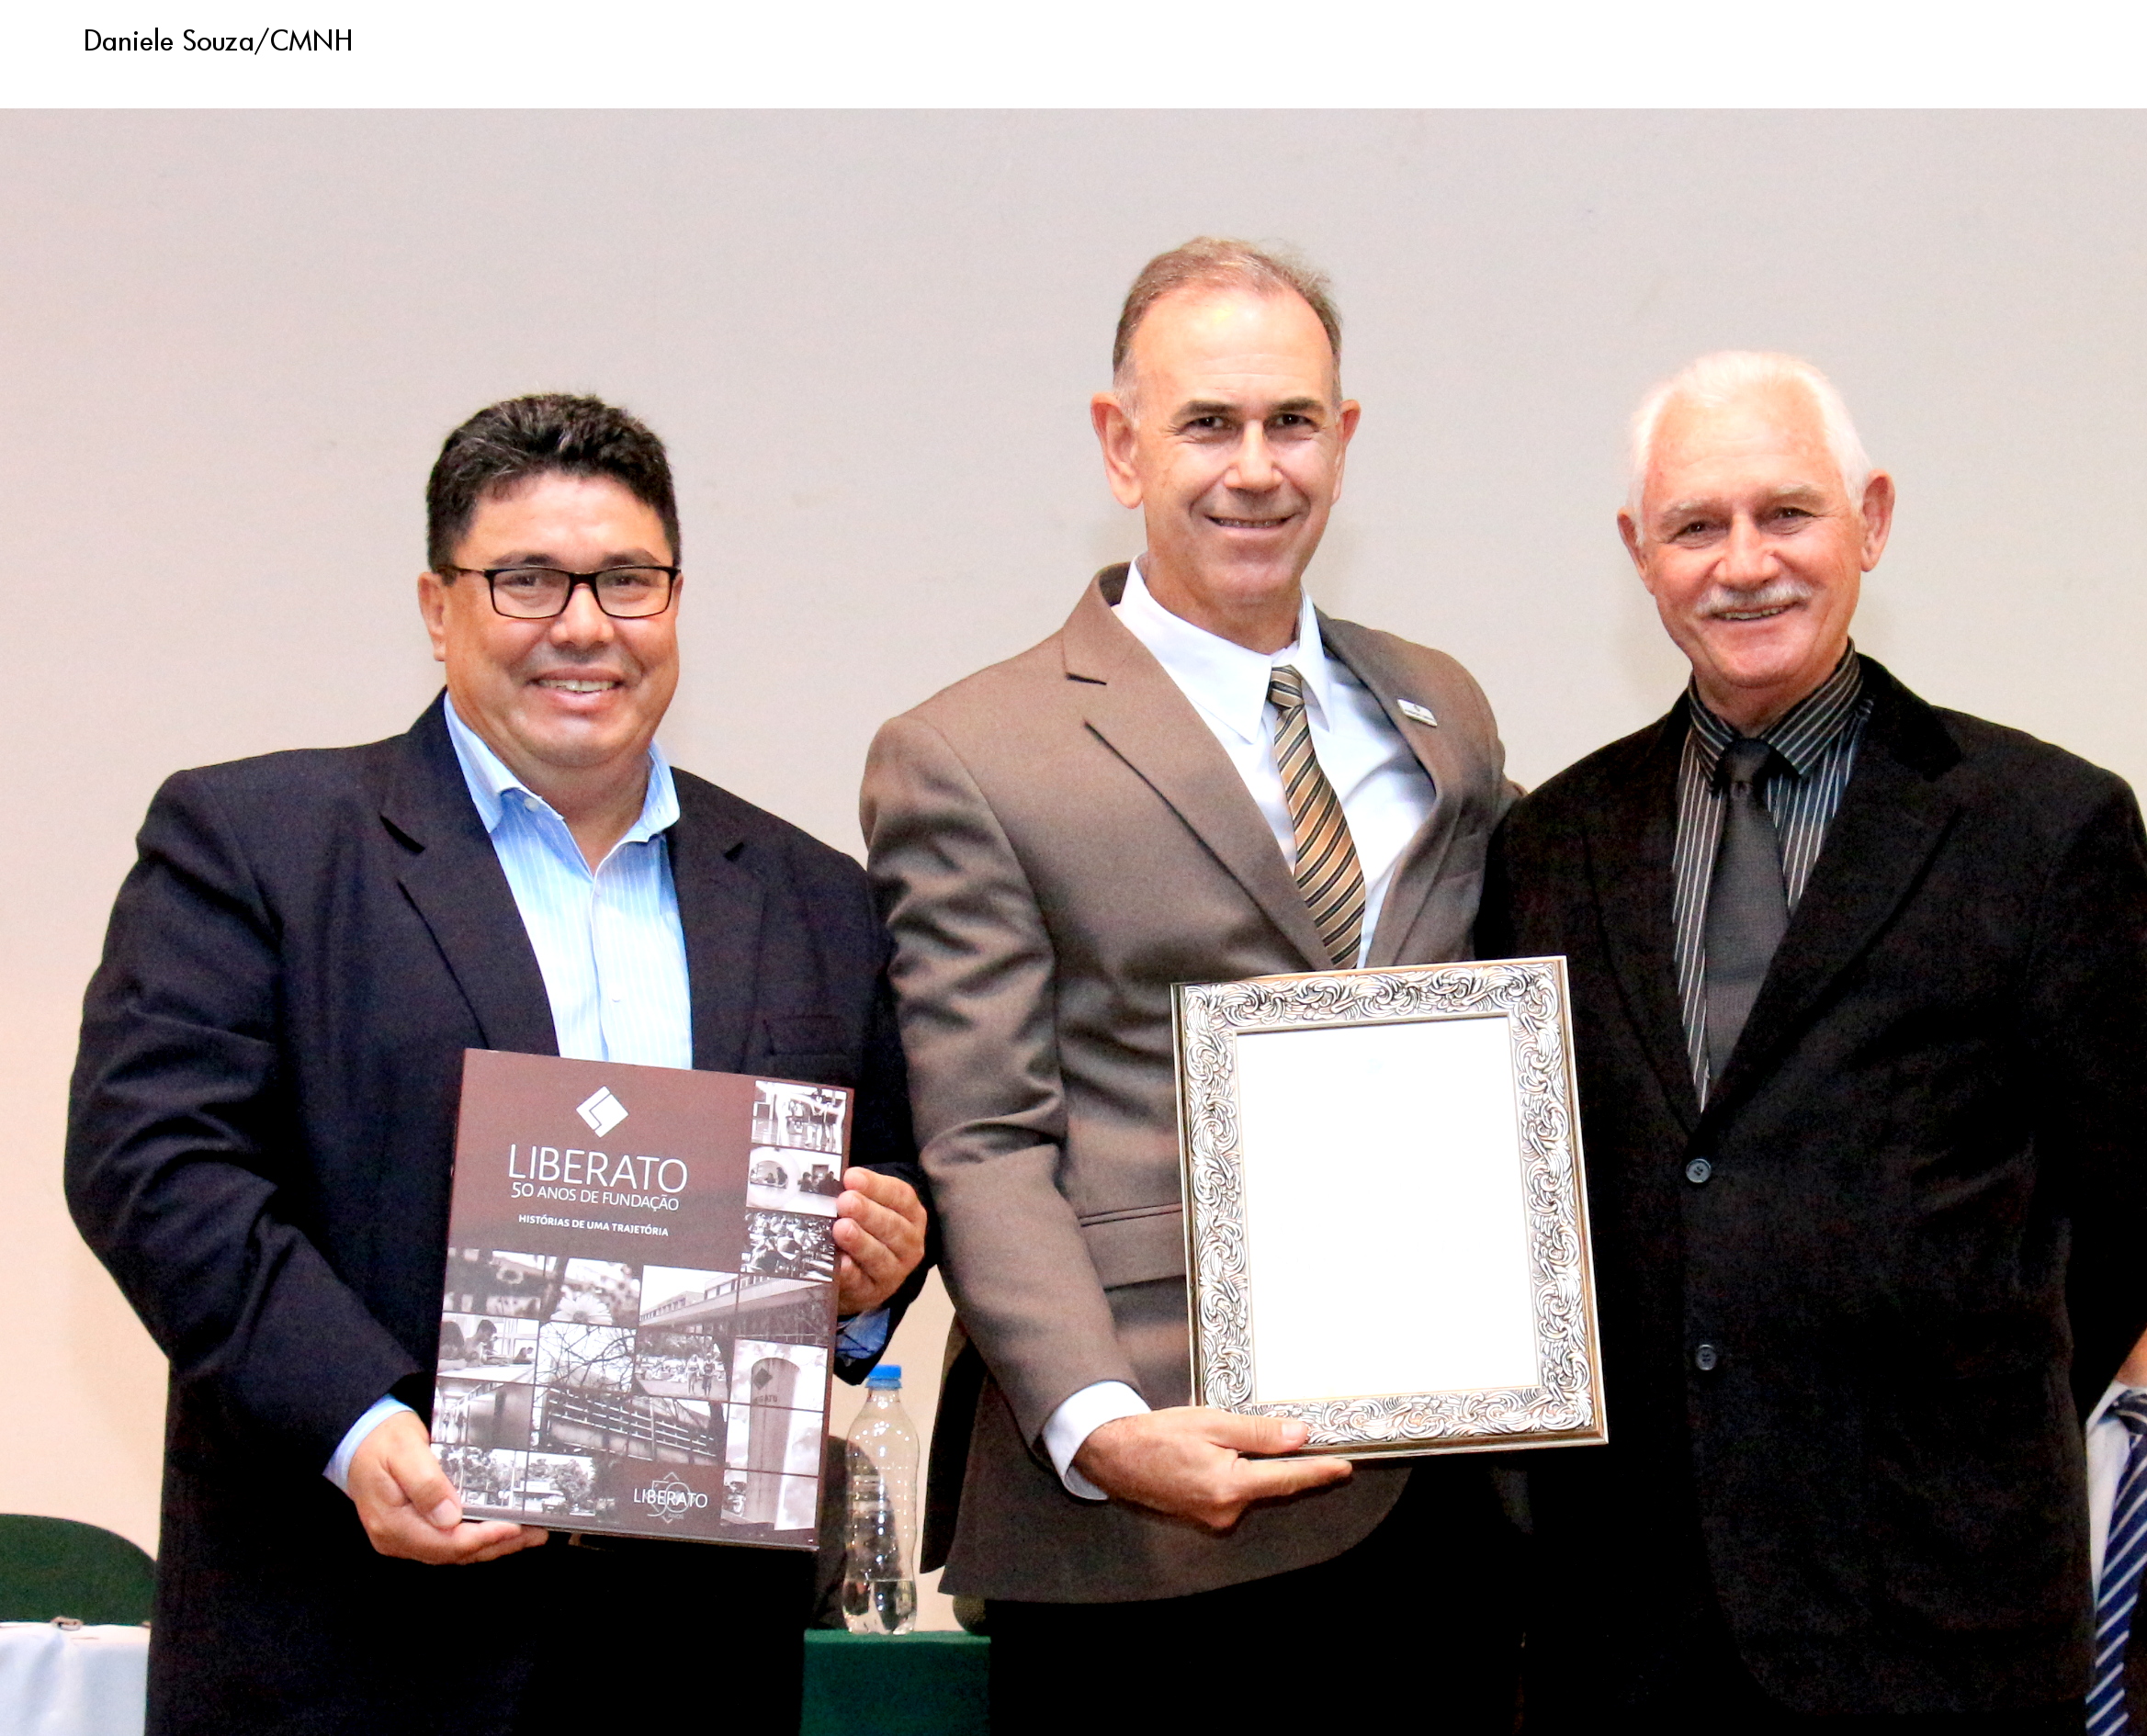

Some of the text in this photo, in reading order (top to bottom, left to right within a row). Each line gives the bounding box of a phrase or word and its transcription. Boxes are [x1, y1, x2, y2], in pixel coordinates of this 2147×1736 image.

[508, 1144, 688, 1193] LIBERATO
[511, 1181, 680, 1212] 50 ANOS DE FUNDAÇÃO
[518, 1213, 669, 1236] HISTÓRIAS DE UMA TRAJETÓRIA
[633, 1488, 708, 1508] LIBERATO
